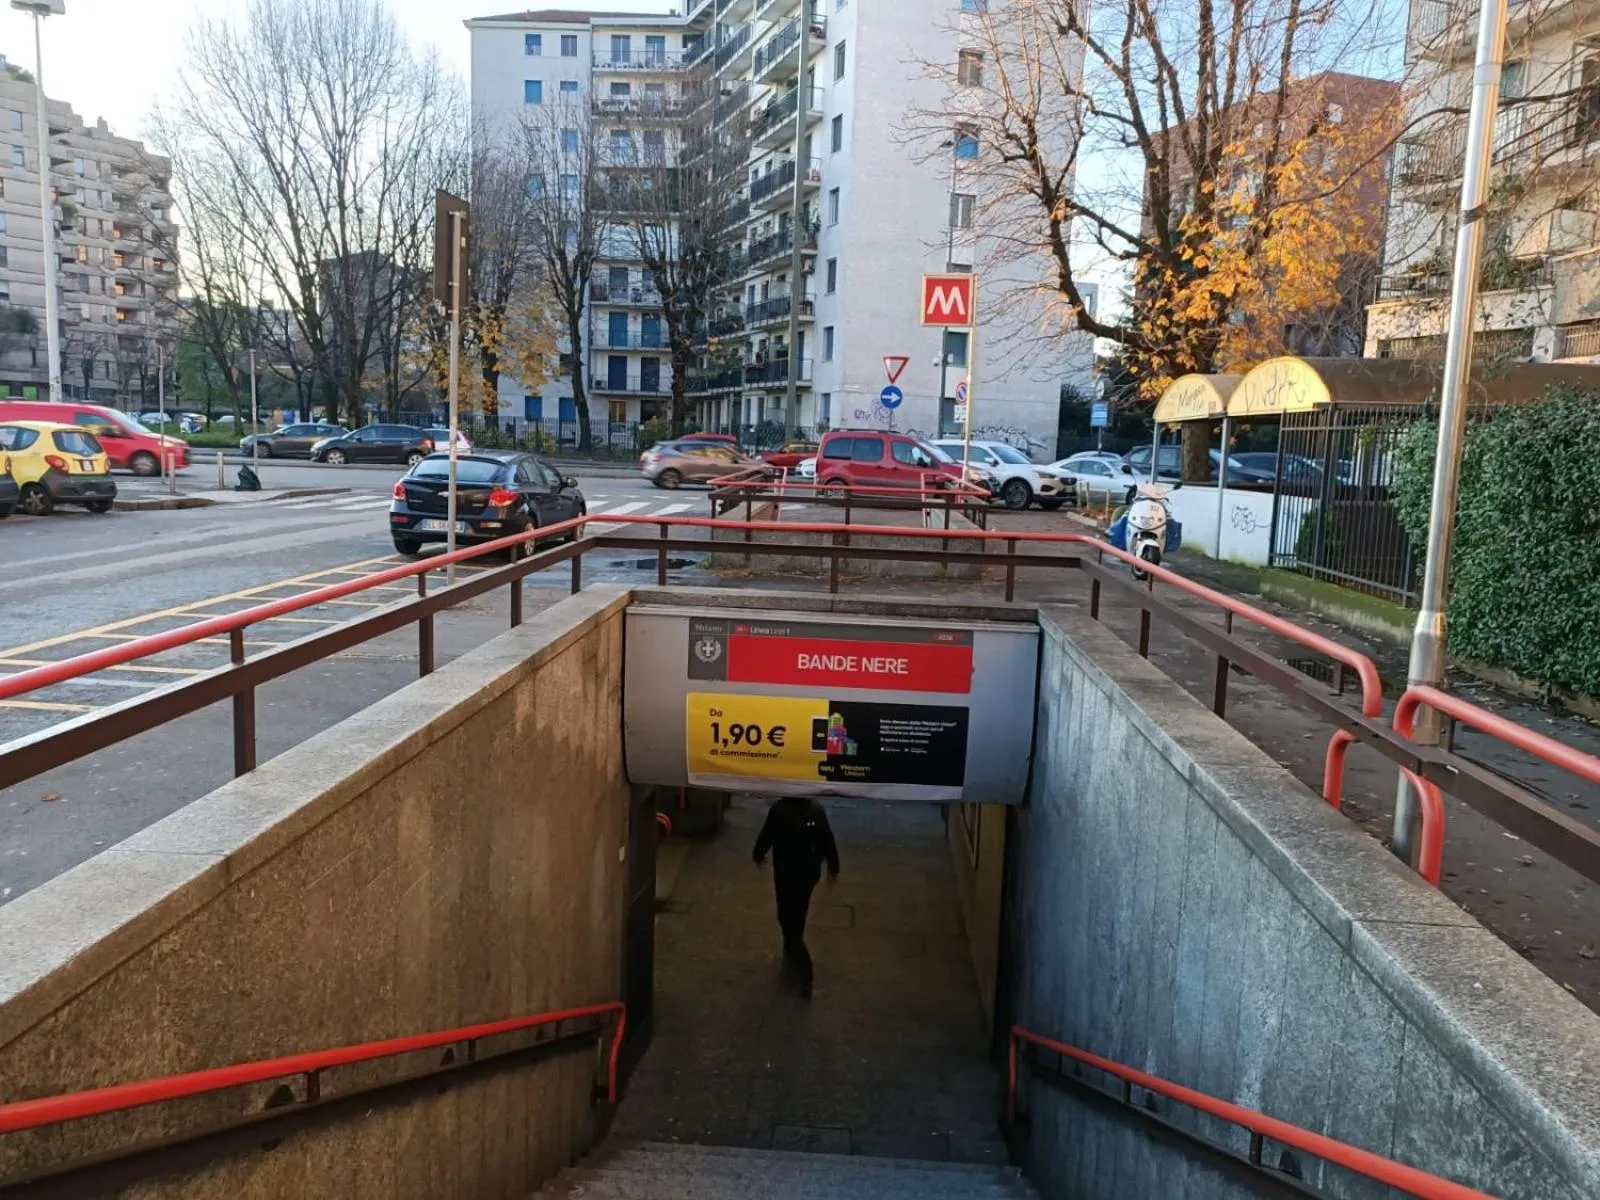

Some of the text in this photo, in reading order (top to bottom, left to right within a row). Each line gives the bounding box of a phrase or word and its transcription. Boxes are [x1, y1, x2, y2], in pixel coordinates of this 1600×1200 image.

[926, 285, 966, 316] M
[797, 653, 909, 676] BANDE NERE
[709, 708, 722, 718] Da
[710, 722, 787, 748] 1,90 €
[709, 748, 718, 756] di
